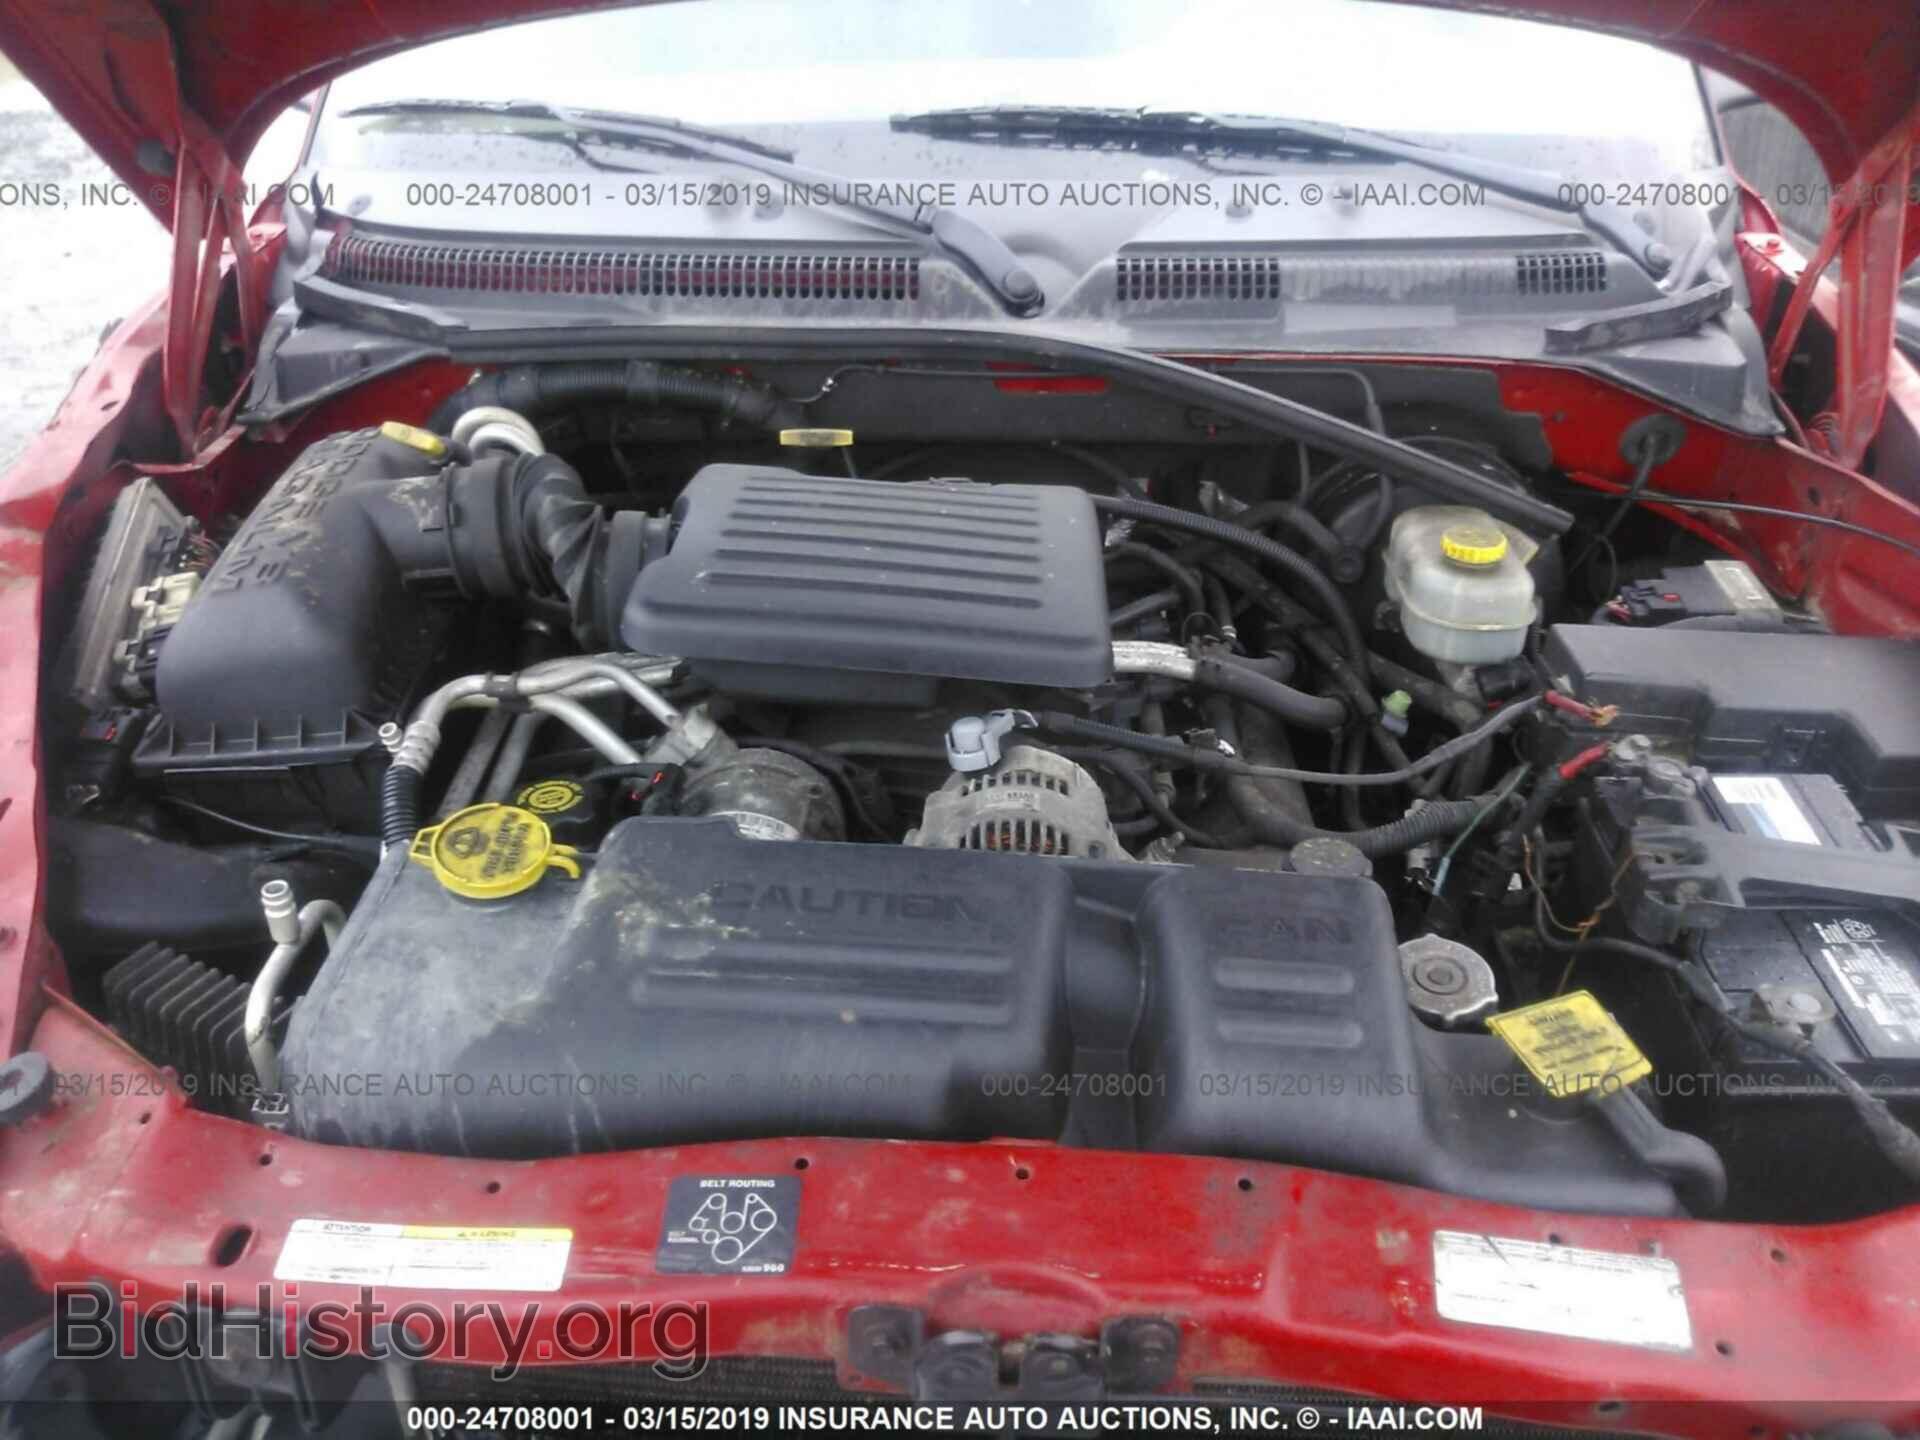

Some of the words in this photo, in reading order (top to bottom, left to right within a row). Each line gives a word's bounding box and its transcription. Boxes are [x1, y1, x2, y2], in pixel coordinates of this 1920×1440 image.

[711, 880, 986, 923] CAUTION
[700, 1179, 727, 1188] BELT
[728, 1179, 775, 1188] ROUTING
